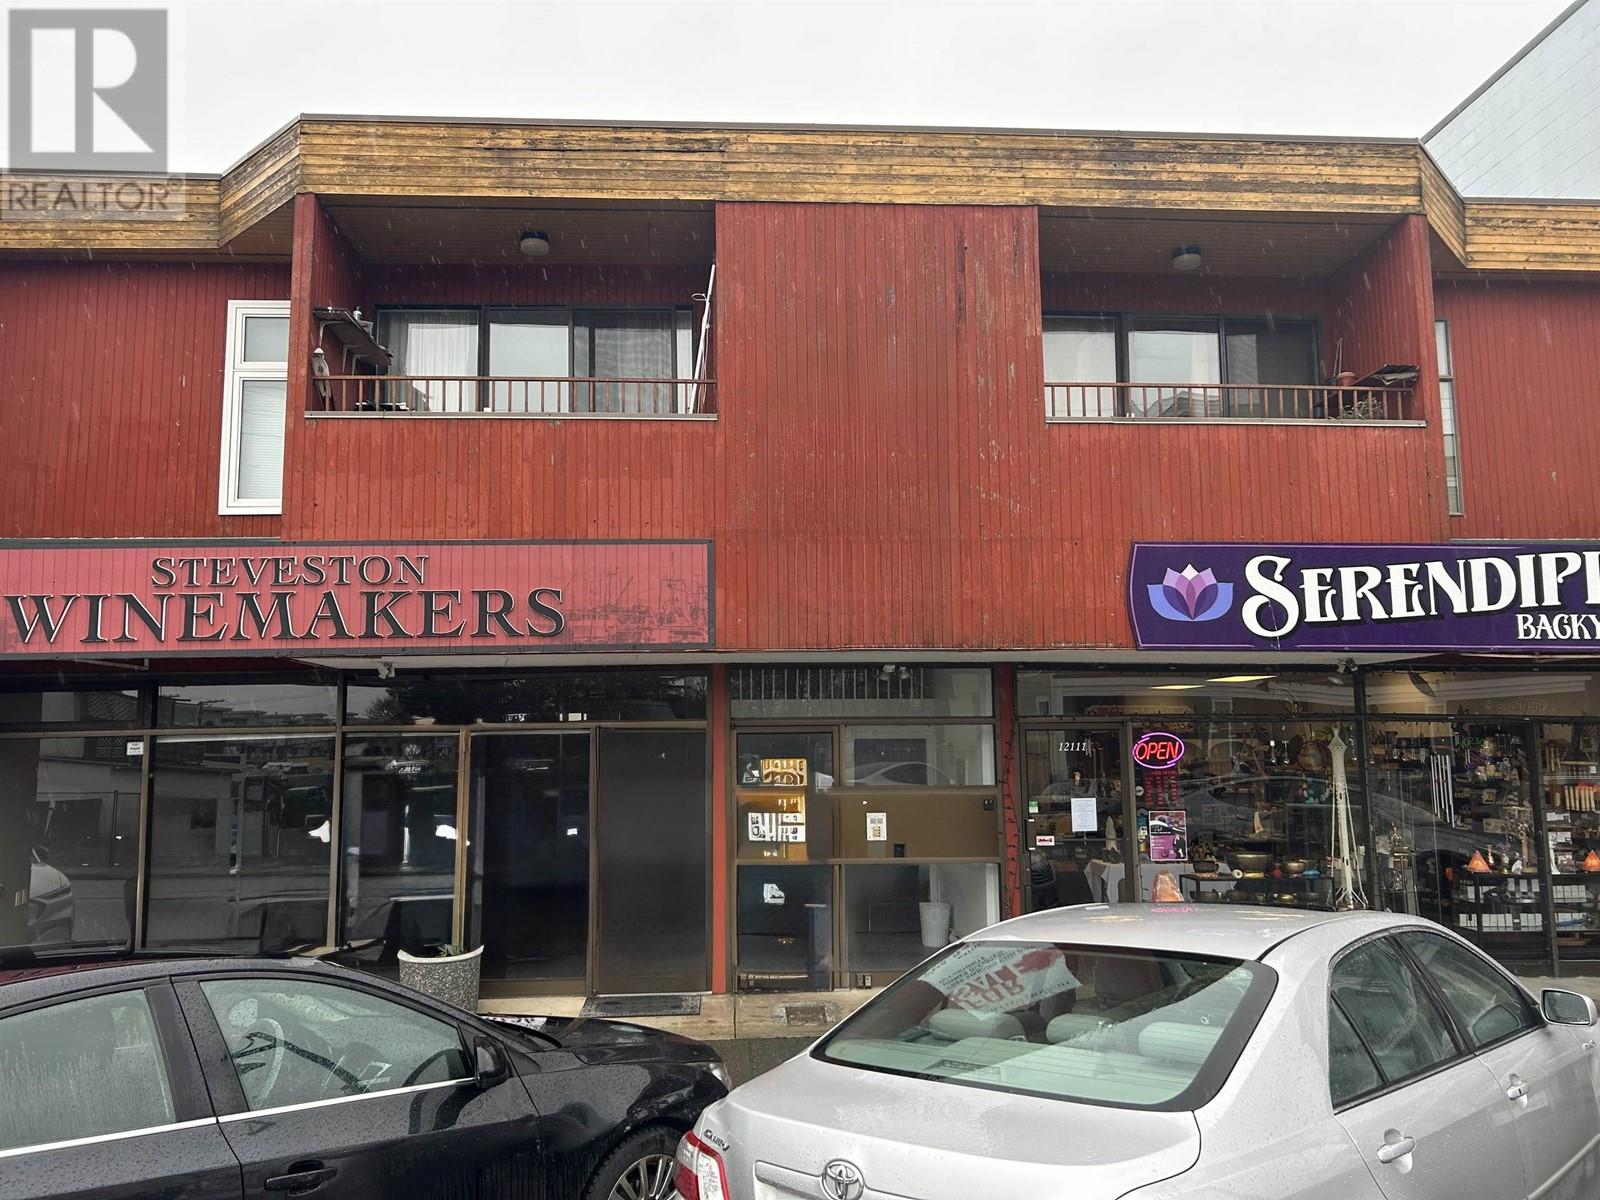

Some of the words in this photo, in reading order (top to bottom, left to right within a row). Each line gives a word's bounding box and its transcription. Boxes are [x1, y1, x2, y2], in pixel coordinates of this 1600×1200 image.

[151, 554, 428, 588] STEVESTON
[3, 588, 564, 645] WINEMAKERS
[1136, 741, 1180, 760] OPEN
